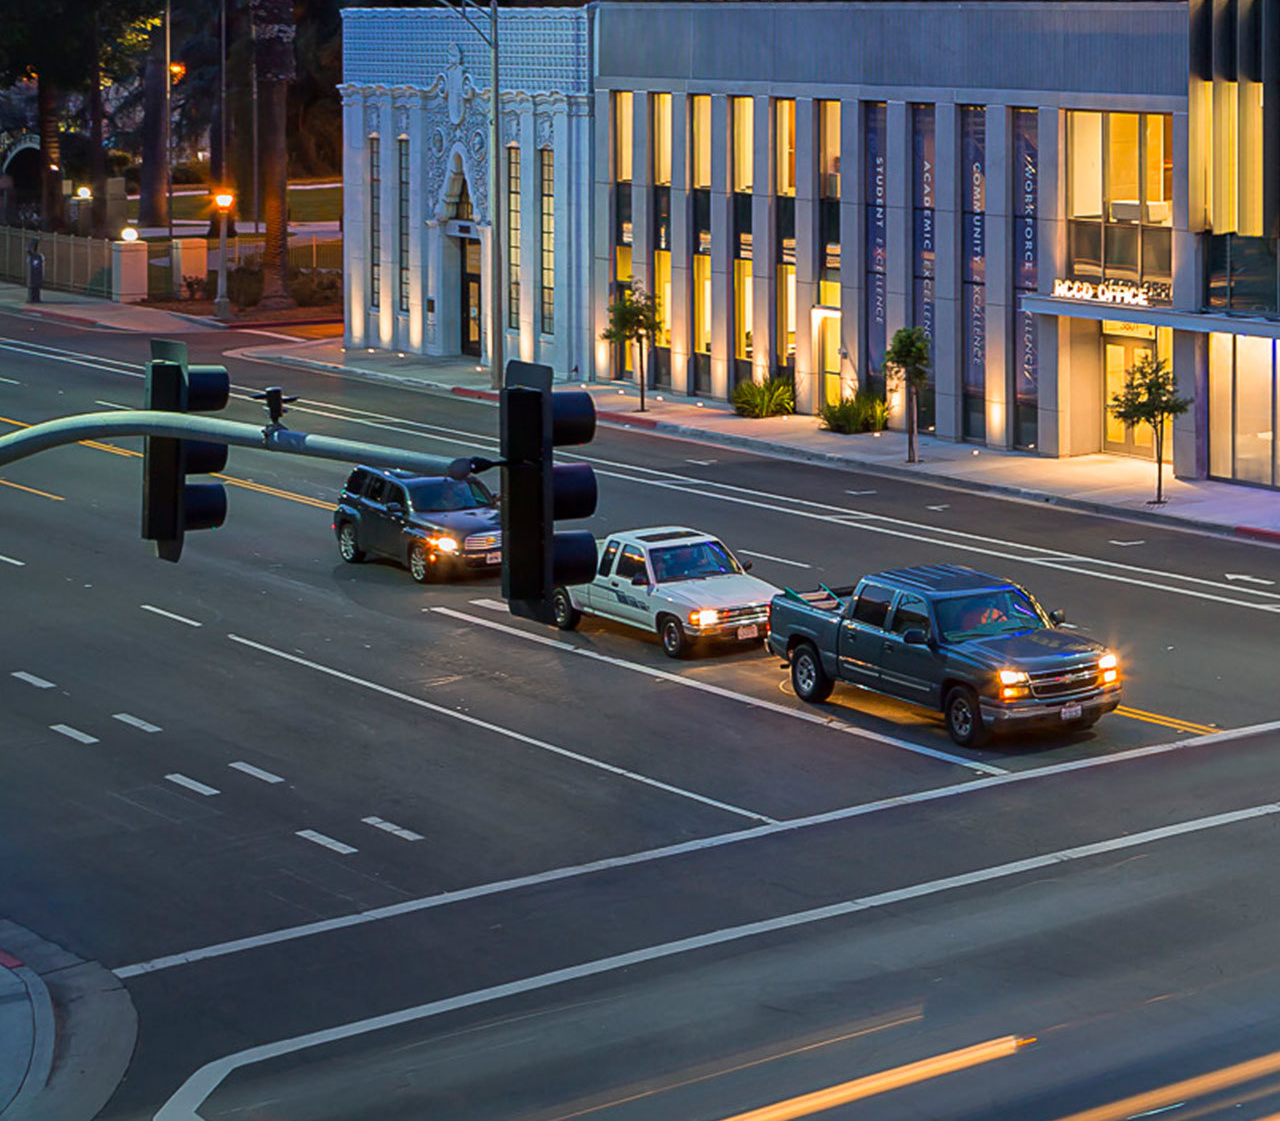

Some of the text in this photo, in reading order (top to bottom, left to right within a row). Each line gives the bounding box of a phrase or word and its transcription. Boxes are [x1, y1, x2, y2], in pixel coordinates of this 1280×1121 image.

[875, 157, 884, 228] STUDENT
[972, 162, 981, 265] COMMUNITY
[1024, 166, 1034, 270] WORKFORCE
[923, 161, 932, 348] ACADEMIC EXCELLENC
[1054, 279, 1149, 305] RCCD OFFICE
